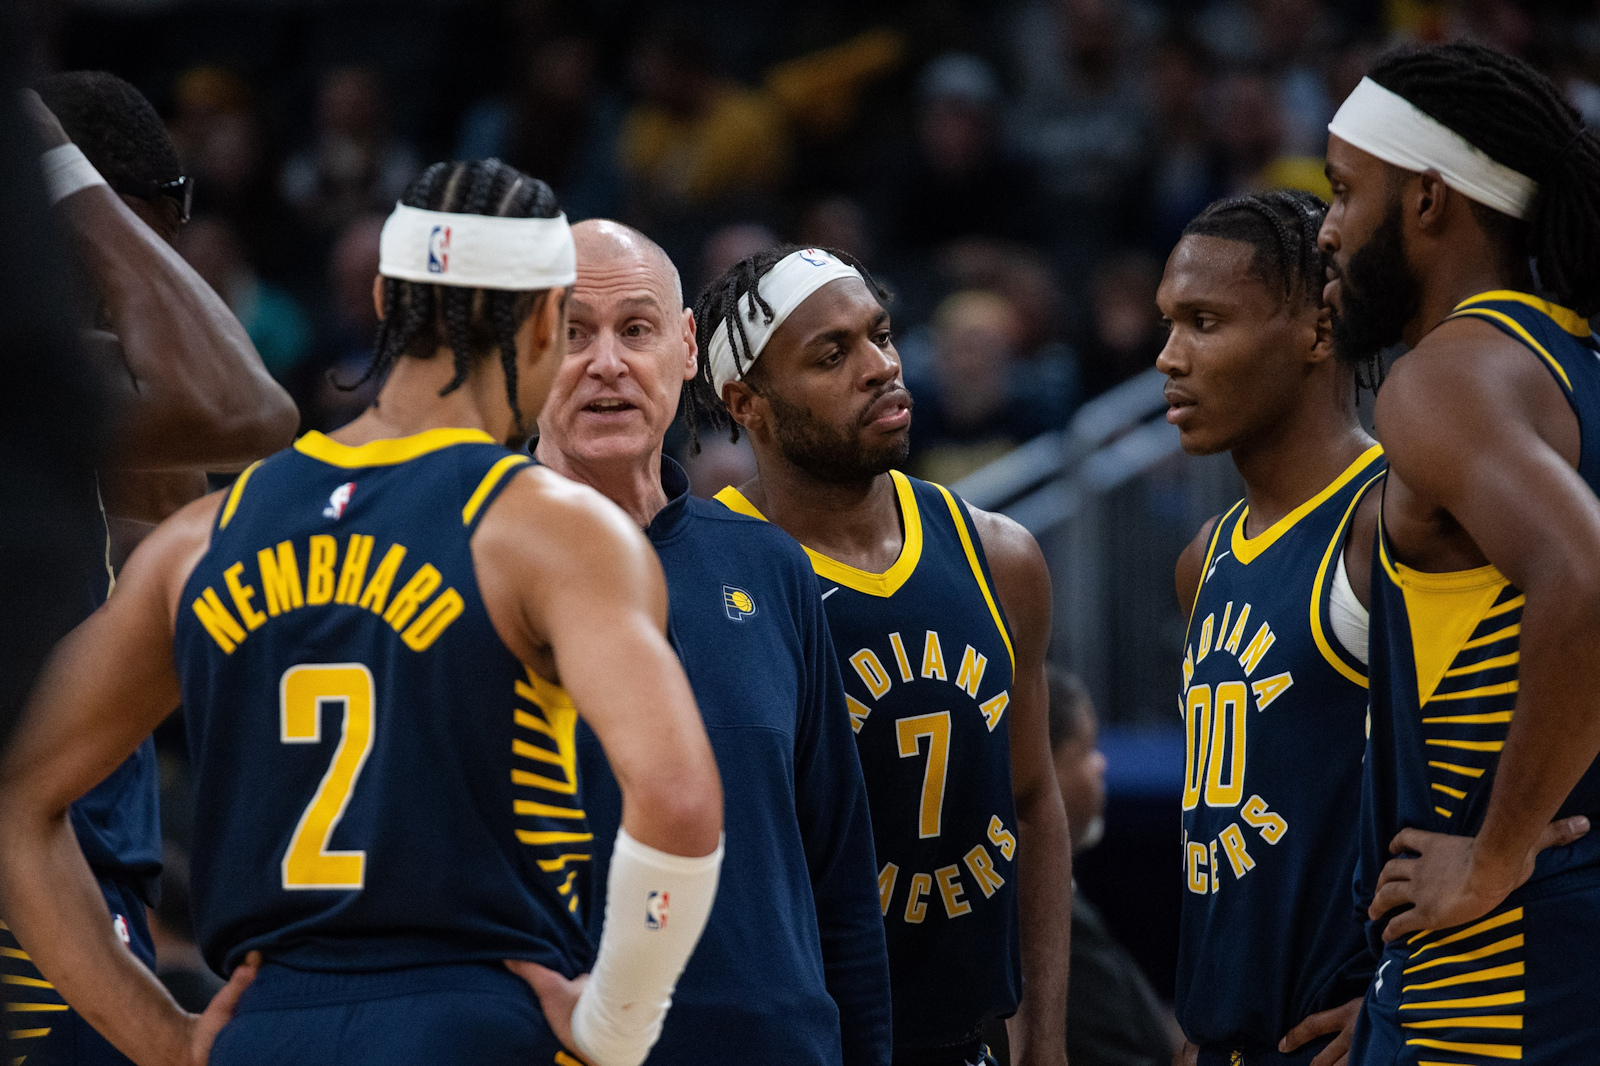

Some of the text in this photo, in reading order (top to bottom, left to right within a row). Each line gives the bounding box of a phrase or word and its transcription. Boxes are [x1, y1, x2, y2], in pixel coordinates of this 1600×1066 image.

[191, 534, 465, 655] NEMBHARD
[844, 629, 1010, 734] NDIANA
[279, 662, 376, 891] 2
[895, 710, 951, 839] 7
[1182, 681, 1247, 812] 00
[876, 814, 1016, 924] ACERS
[1181, 794, 1288, 895] CERS
